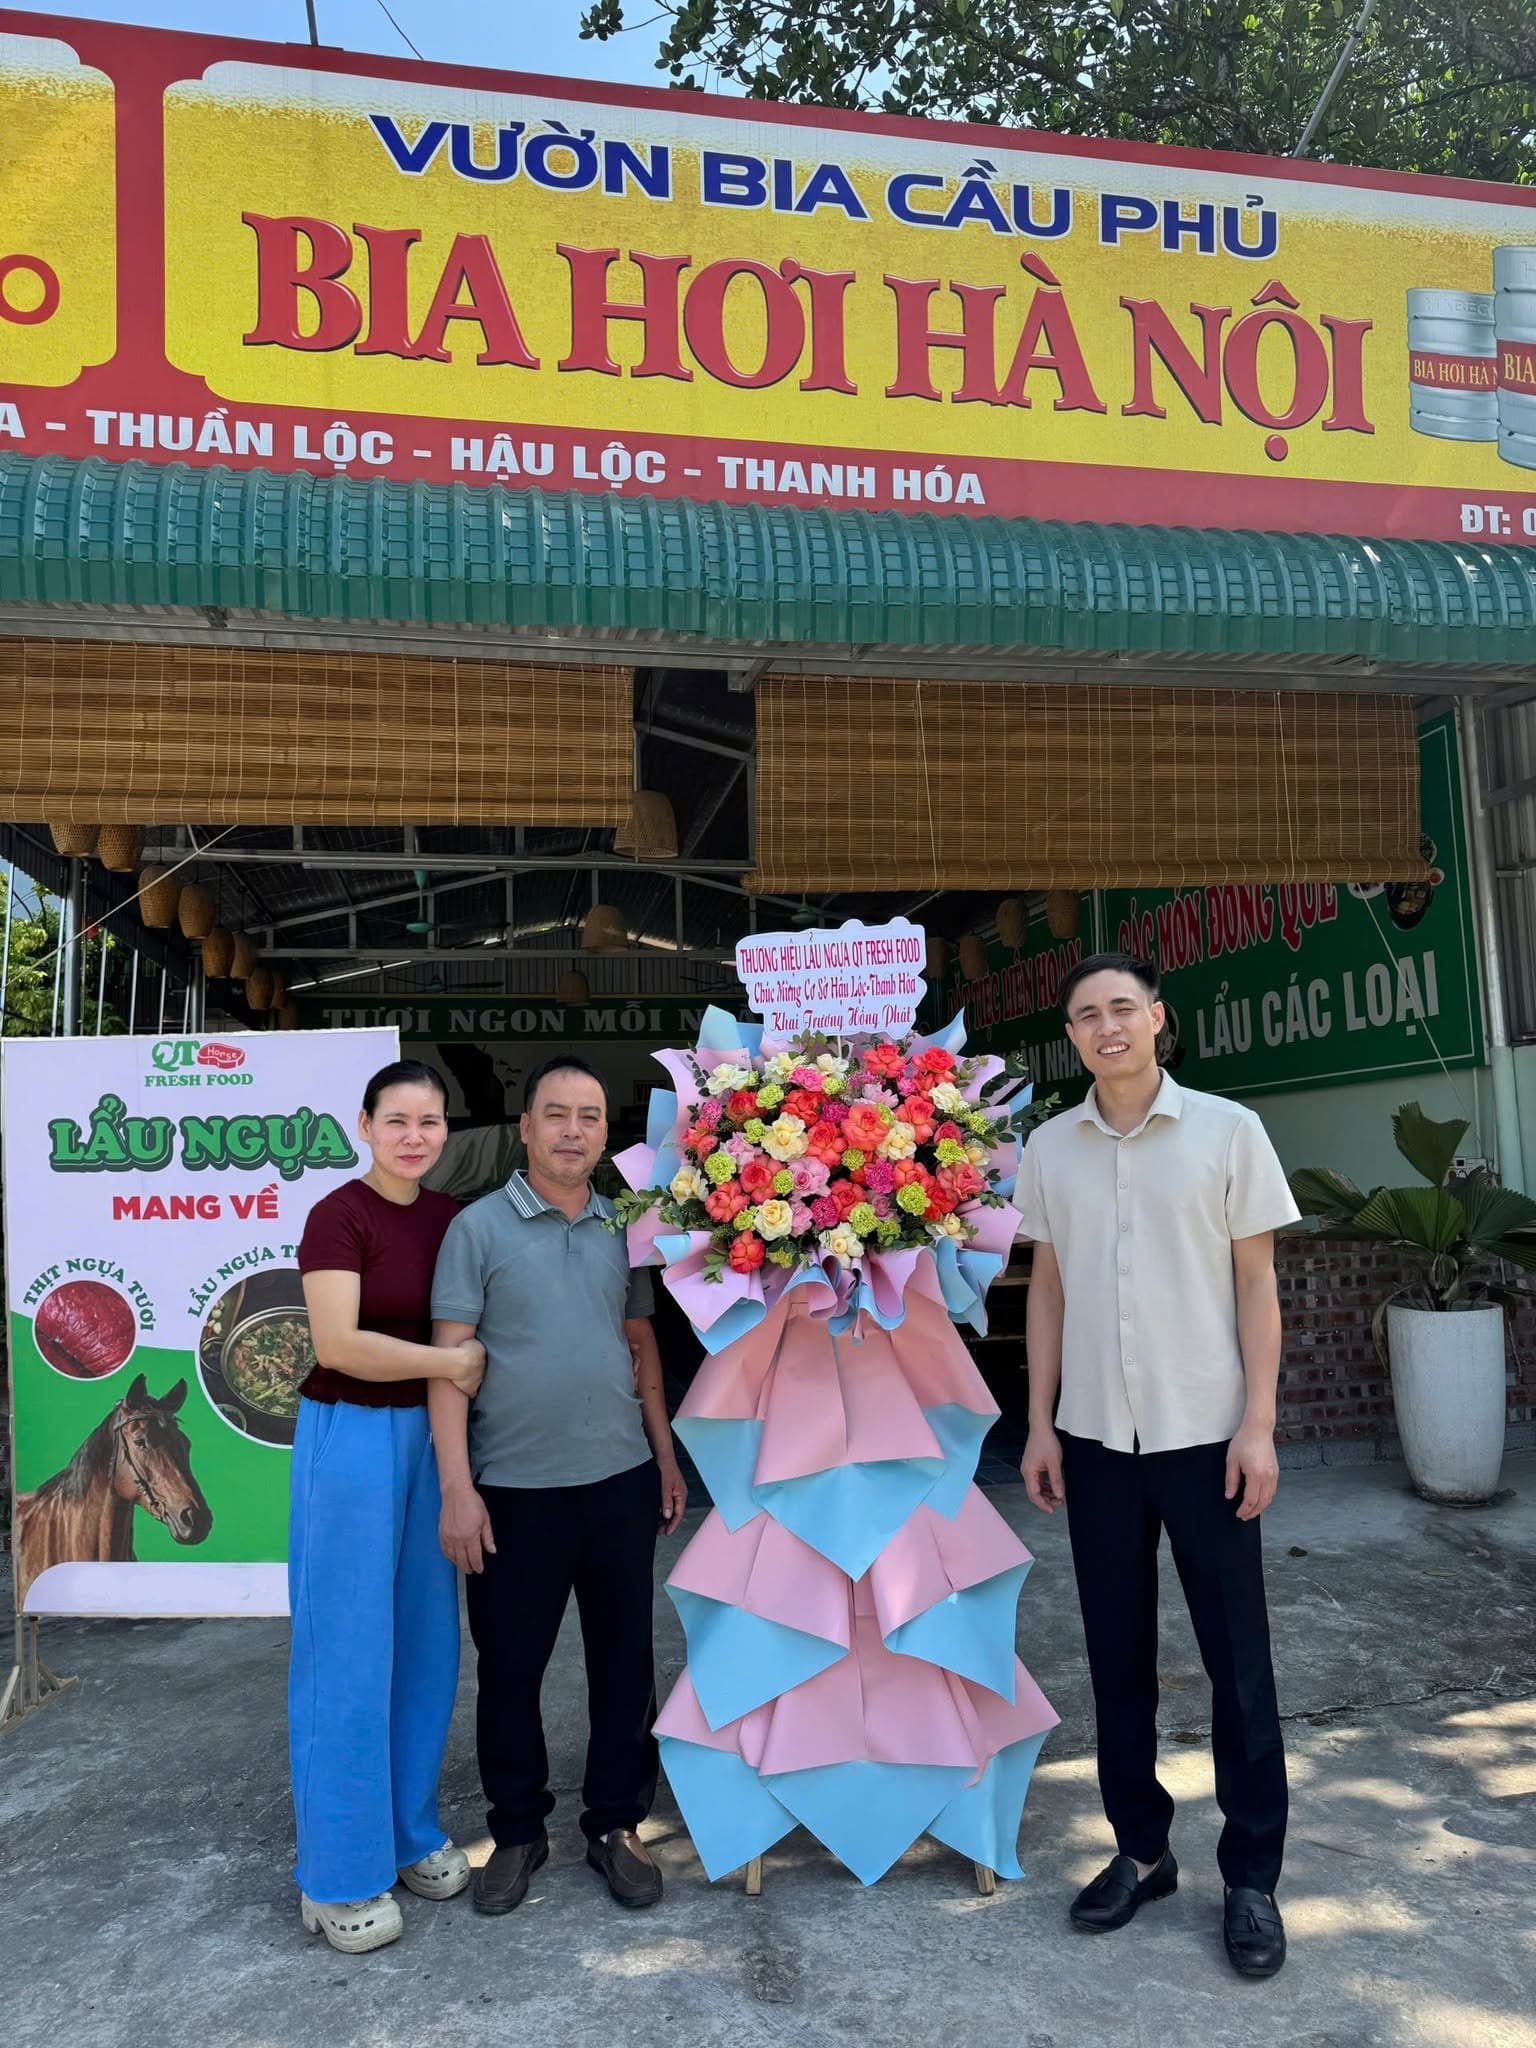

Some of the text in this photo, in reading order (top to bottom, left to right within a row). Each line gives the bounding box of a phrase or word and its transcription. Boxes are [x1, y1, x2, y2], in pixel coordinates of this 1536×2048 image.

[369, 113, 1278, 259] VƯỜN BIA CẦU PHỦ
[242, 211, 1375, 461] BIA HƠI HÀ NỘI
[1414, 359, 1435, 380] BIA
[1439, 362, 1466, 383] HƠI
[1469, 361, 1489, 385] HÀ
[1504, 353, 1536, 384] BIA
[86, 407, 273, 457] THUẦN
[293, 422, 394, 471] LỘC
[451, 433, 555, 481] HẬU
[573, 441, 666, 490] LỘC
[717, 456, 876, 499] THANH
[892, 464, 985, 505] HÓA
[1460, 503, 1511, 535] ĐT:
[740, 945, 778, 973] THƯƠNG
[780, 938, 801, 977] HIỆU
[852, 941, 863, 968] QT
[866, 939, 893, 964] FRESH
[896, 937, 920, 963] FOOD
[754, 981, 775, 1004] Chúc
[1197, 950, 1440, 1059] LẨU CÁC LOẠI
[322, 1006, 432, 1033] TƯƠI
[447, 1007, 566, 1034] NGON
[583, 999, 663, 1034] MỖI
[771, 1012, 800, 1031] Khai
[151, 1040, 238, 1072] QT Horse
[144, 1073, 253, 1087] FRESH FOOD
[49, 1094, 359, 1181] LẨU NGỰA
[113, 1183, 279, 1221] MANG VỀ
[216, 1245, 276, 1281] NGỰA
[23, 1257, 157, 1331] THỊT NGỰA TƯƠI
